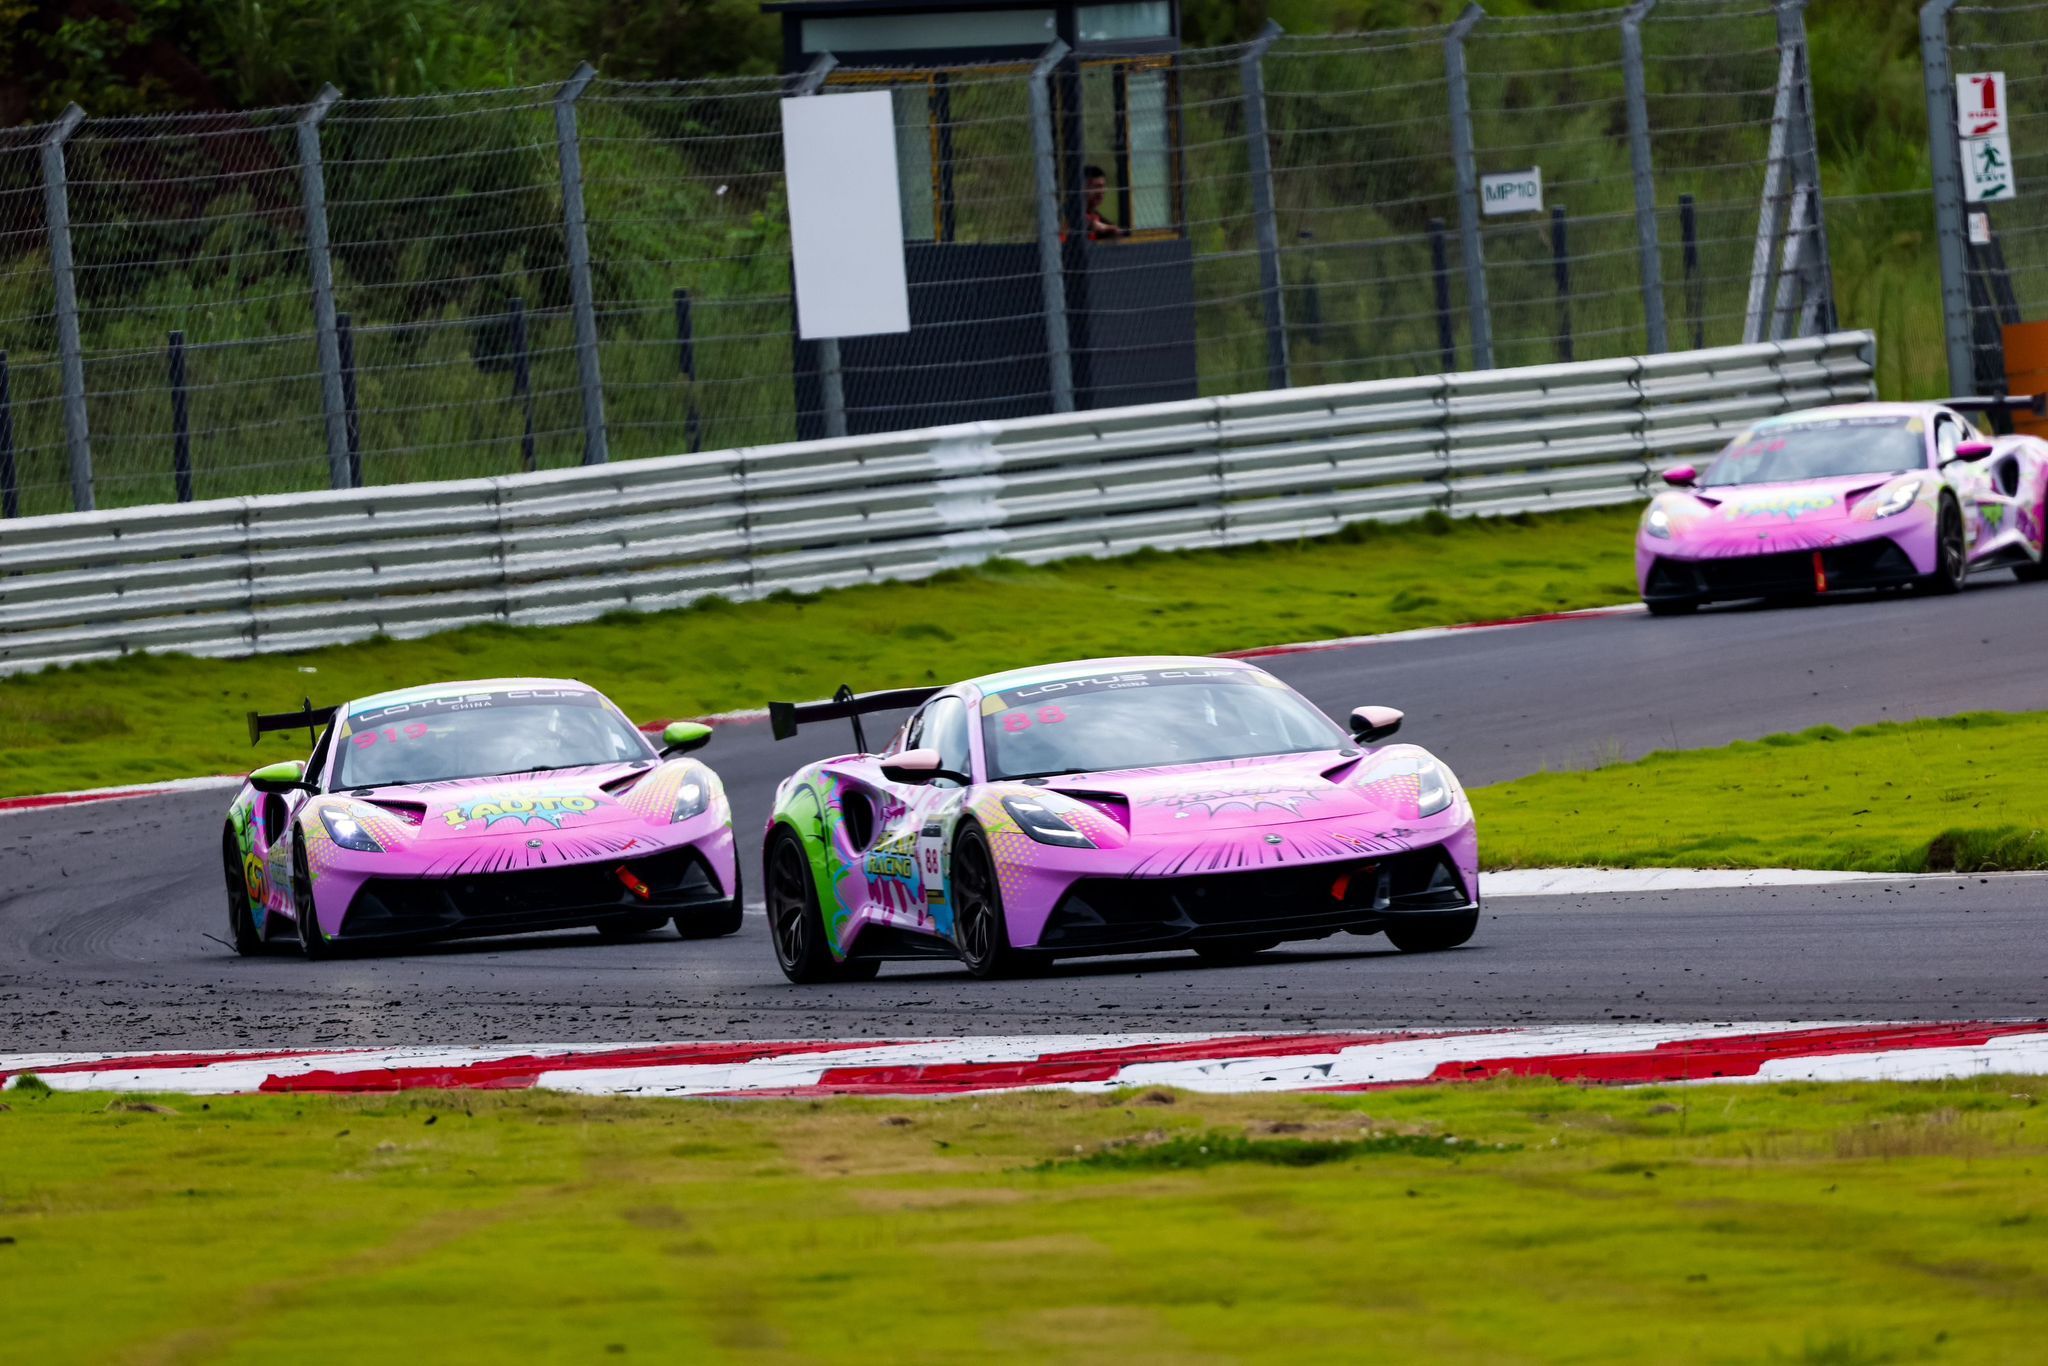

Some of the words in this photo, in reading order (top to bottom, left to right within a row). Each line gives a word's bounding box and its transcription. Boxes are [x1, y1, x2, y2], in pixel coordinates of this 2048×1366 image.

[1485, 181, 1537, 201] MP10
[1017, 673, 1148, 698] LOTUS
[1160, 670, 1235, 678] CUP
[1109, 681, 1150, 690] CHINA
[359, 692, 492, 722] LOTUS
[507, 690, 585, 699] CUP
[451, 701, 492, 711] CHINA
[1002, 705, 1067, 733] 88
[352, 722, 429, 750] 919
[867, 856, 912, 878] RACING
[925, 847, 939, 874] 88
